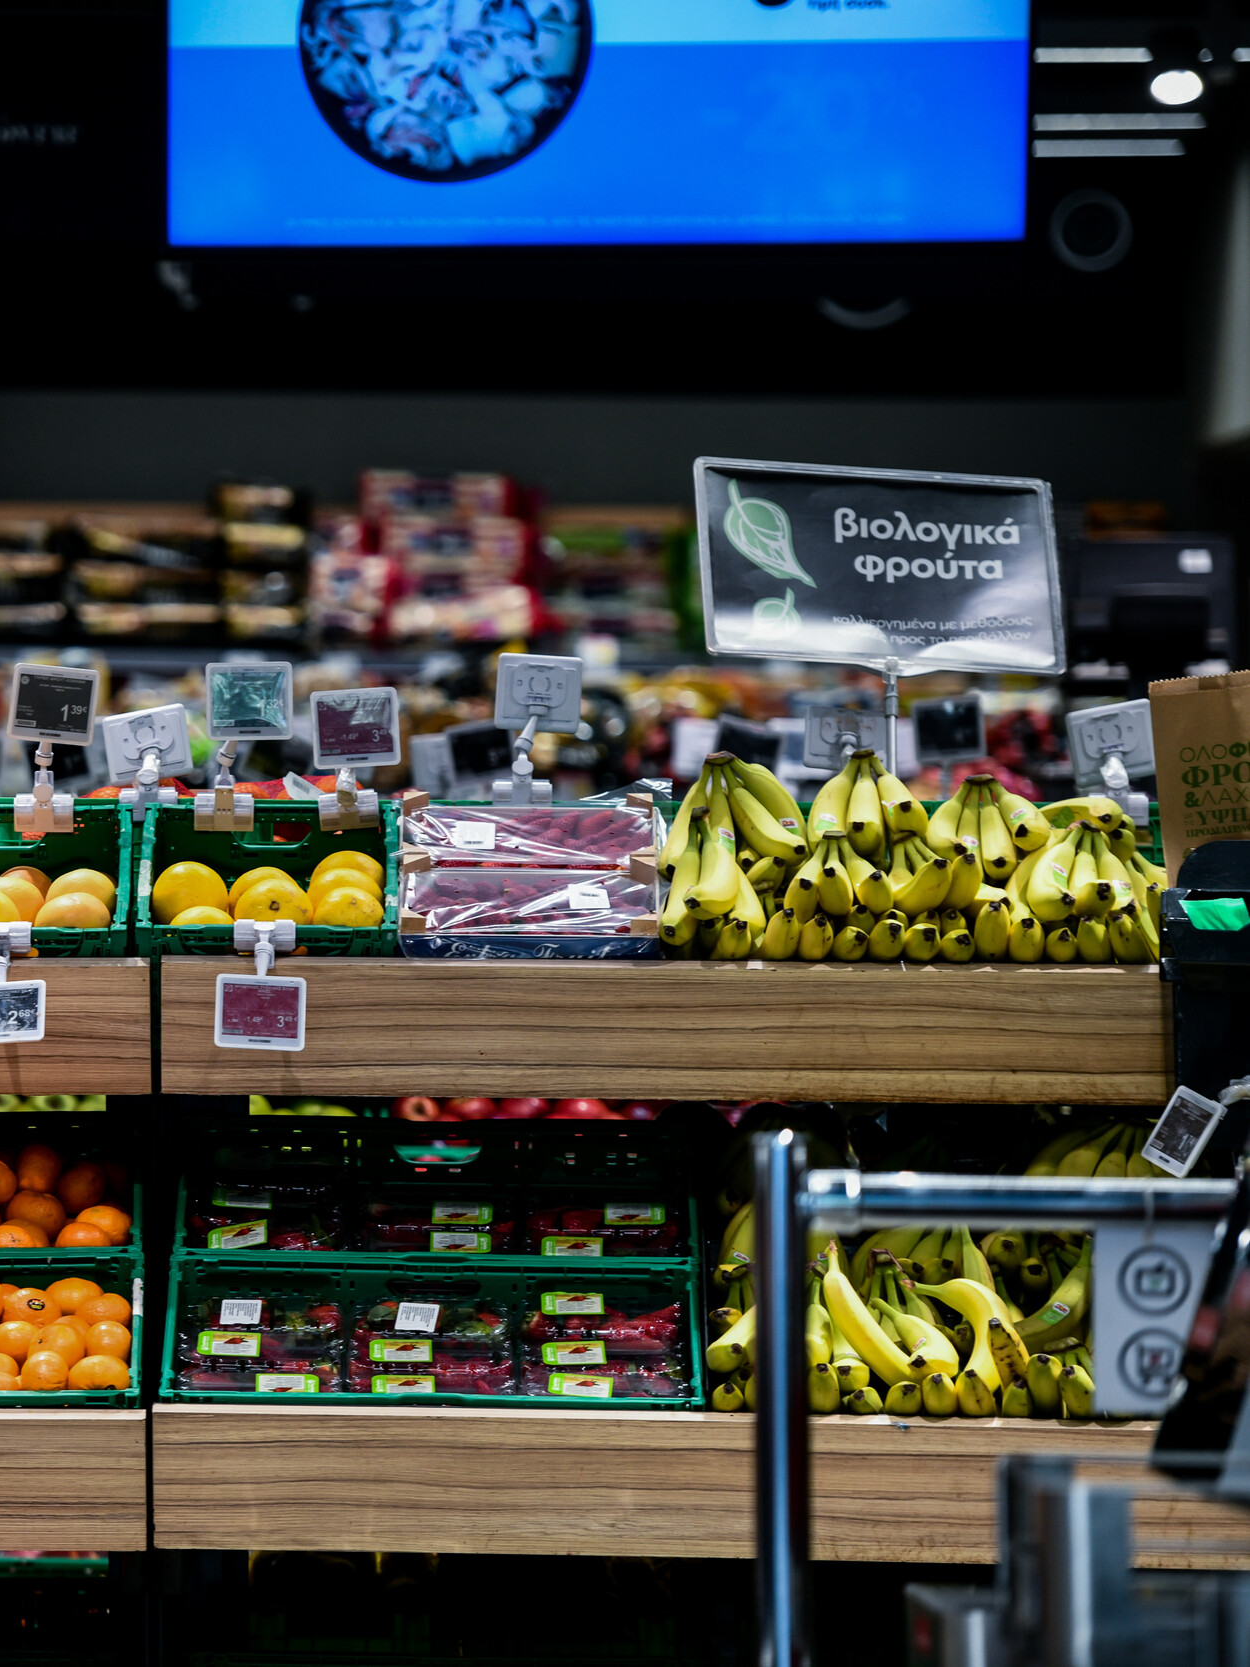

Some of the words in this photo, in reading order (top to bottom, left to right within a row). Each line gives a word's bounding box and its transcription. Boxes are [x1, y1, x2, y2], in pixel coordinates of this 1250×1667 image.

[834, 507, 1020, 550] βιολογικά
[854, 551, 1003, 583] φρούτα
[939, 620, 958, 631] με
[890, 635, 926, 646] προς
[1180, 742, 1250, 763] ΟΛΟΦ
[1196, 807, 1250, 825] ΥΨΗ
